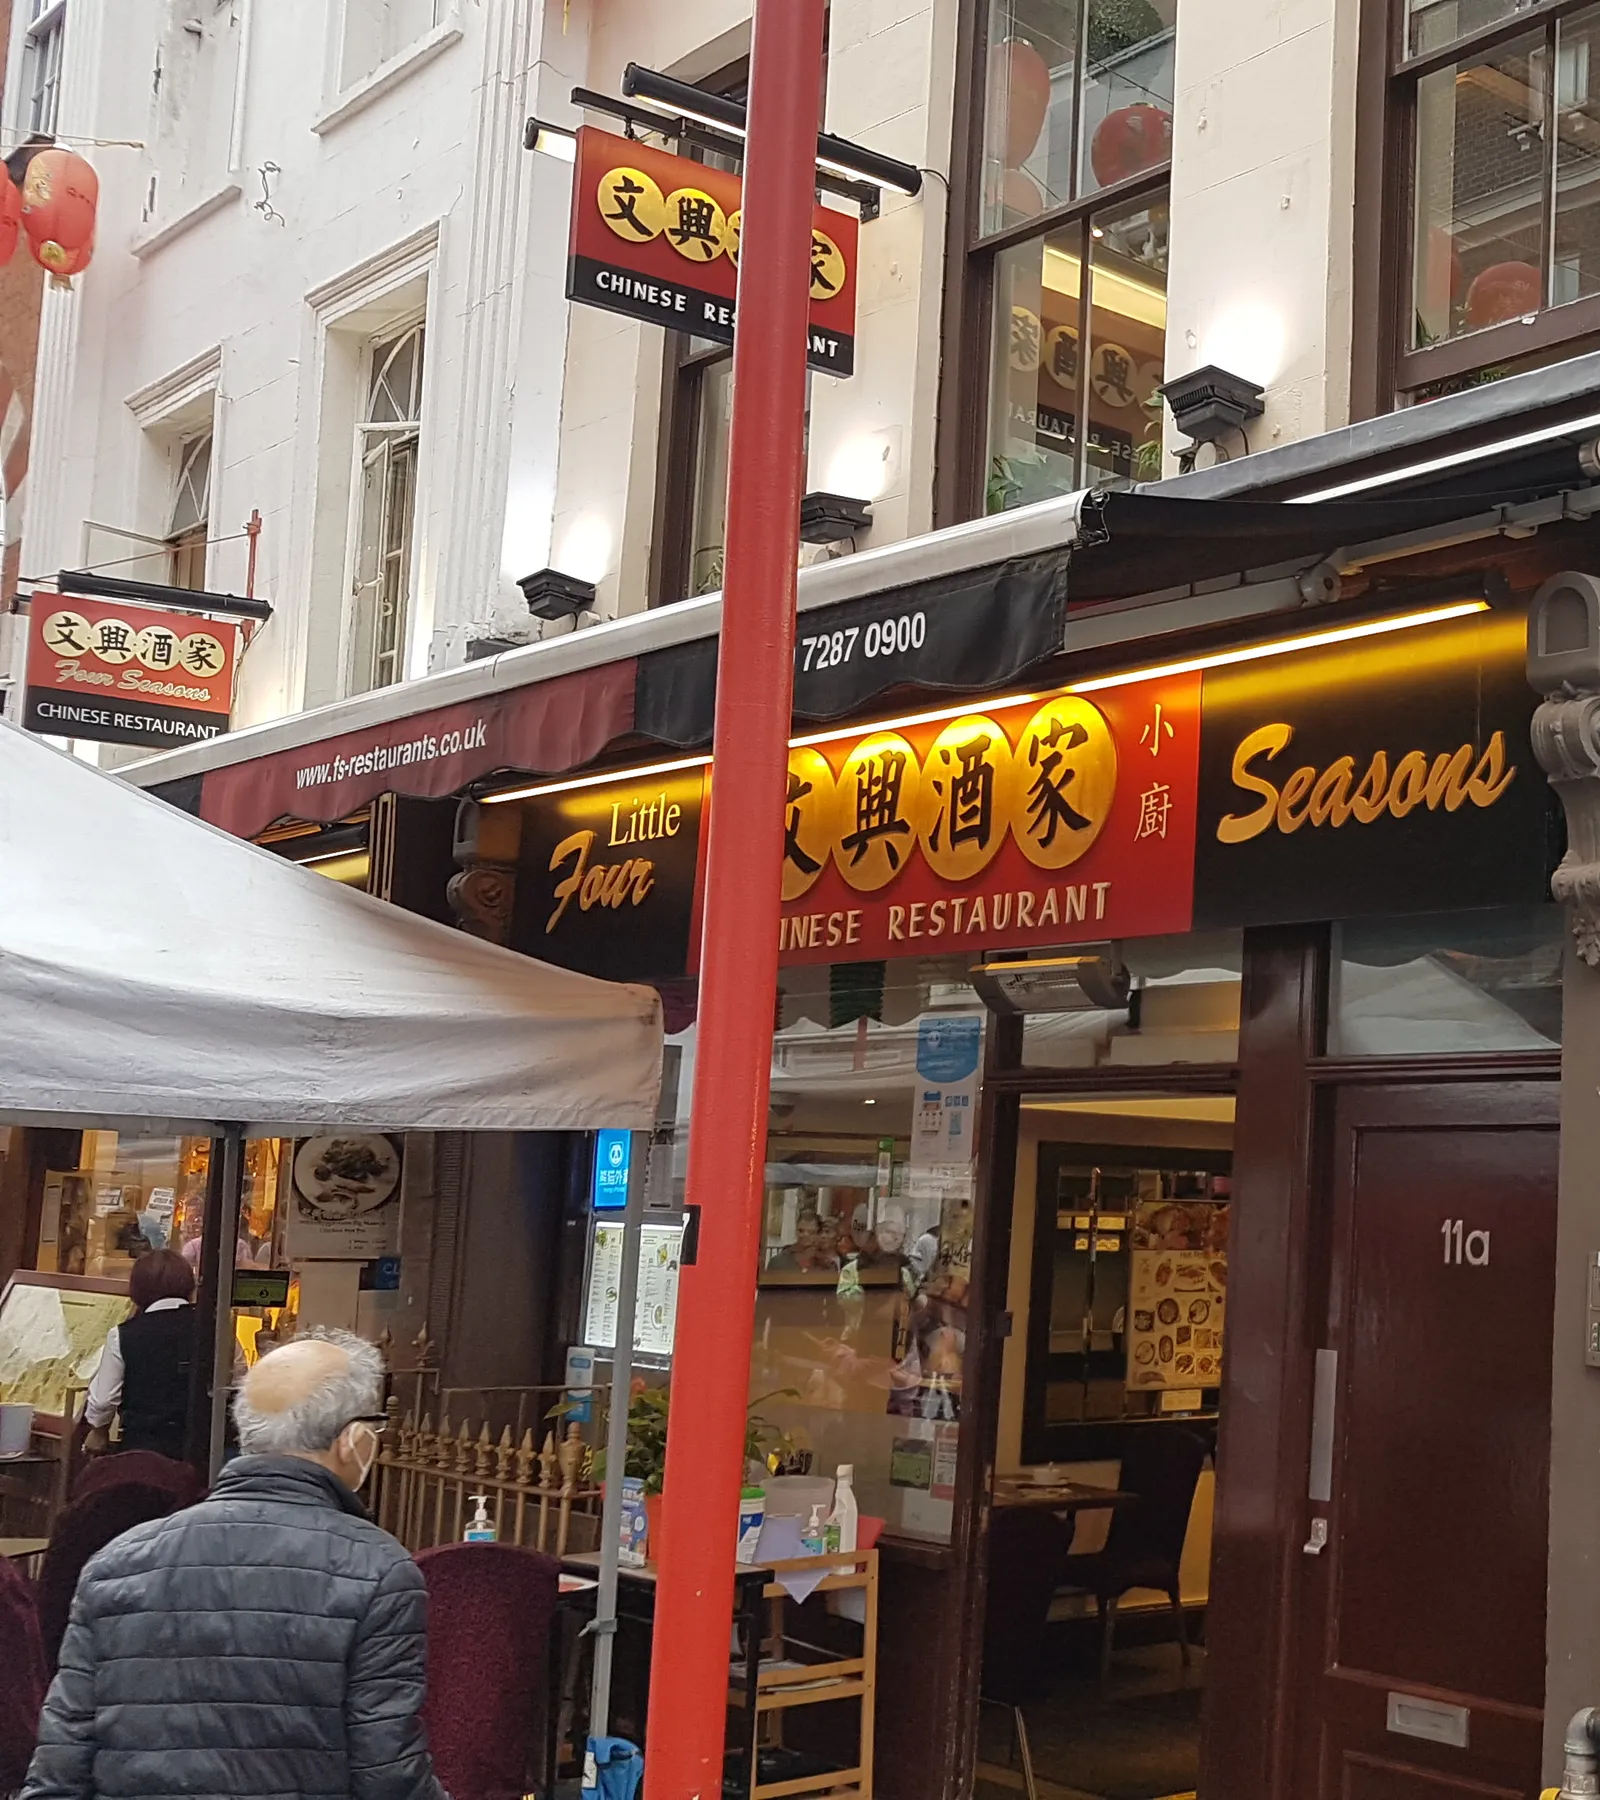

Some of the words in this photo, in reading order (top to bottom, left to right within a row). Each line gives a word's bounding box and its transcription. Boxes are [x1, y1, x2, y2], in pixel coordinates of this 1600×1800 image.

[605, 175, 836, 291] 文興家
[595, 270, 688, 313] CHINESE
[49, 615, 217, 671] 文興酒家
[801, 626, 859, 673] 7287
[863, 611, 926, 659] 0900
[54, 659, 114, 687] Four
[117, 669, 211, 702] Seasons
[36, 702, 111, 726] CHINESE
[113, 712, 220, 739] RESTAURANT
[296, 718, 487, 790] www.fs-restaurants.co.uk
[545, 829, 655, 934] Four
[1215, 722, 1519, 846] Seasons
[607, 792, 681, 847] Little
[779, 909, 863, 951] INESE
[887, 881, 1112, 941] RESTAURANT
[1440, 1218, 1491, 1267] 11a
